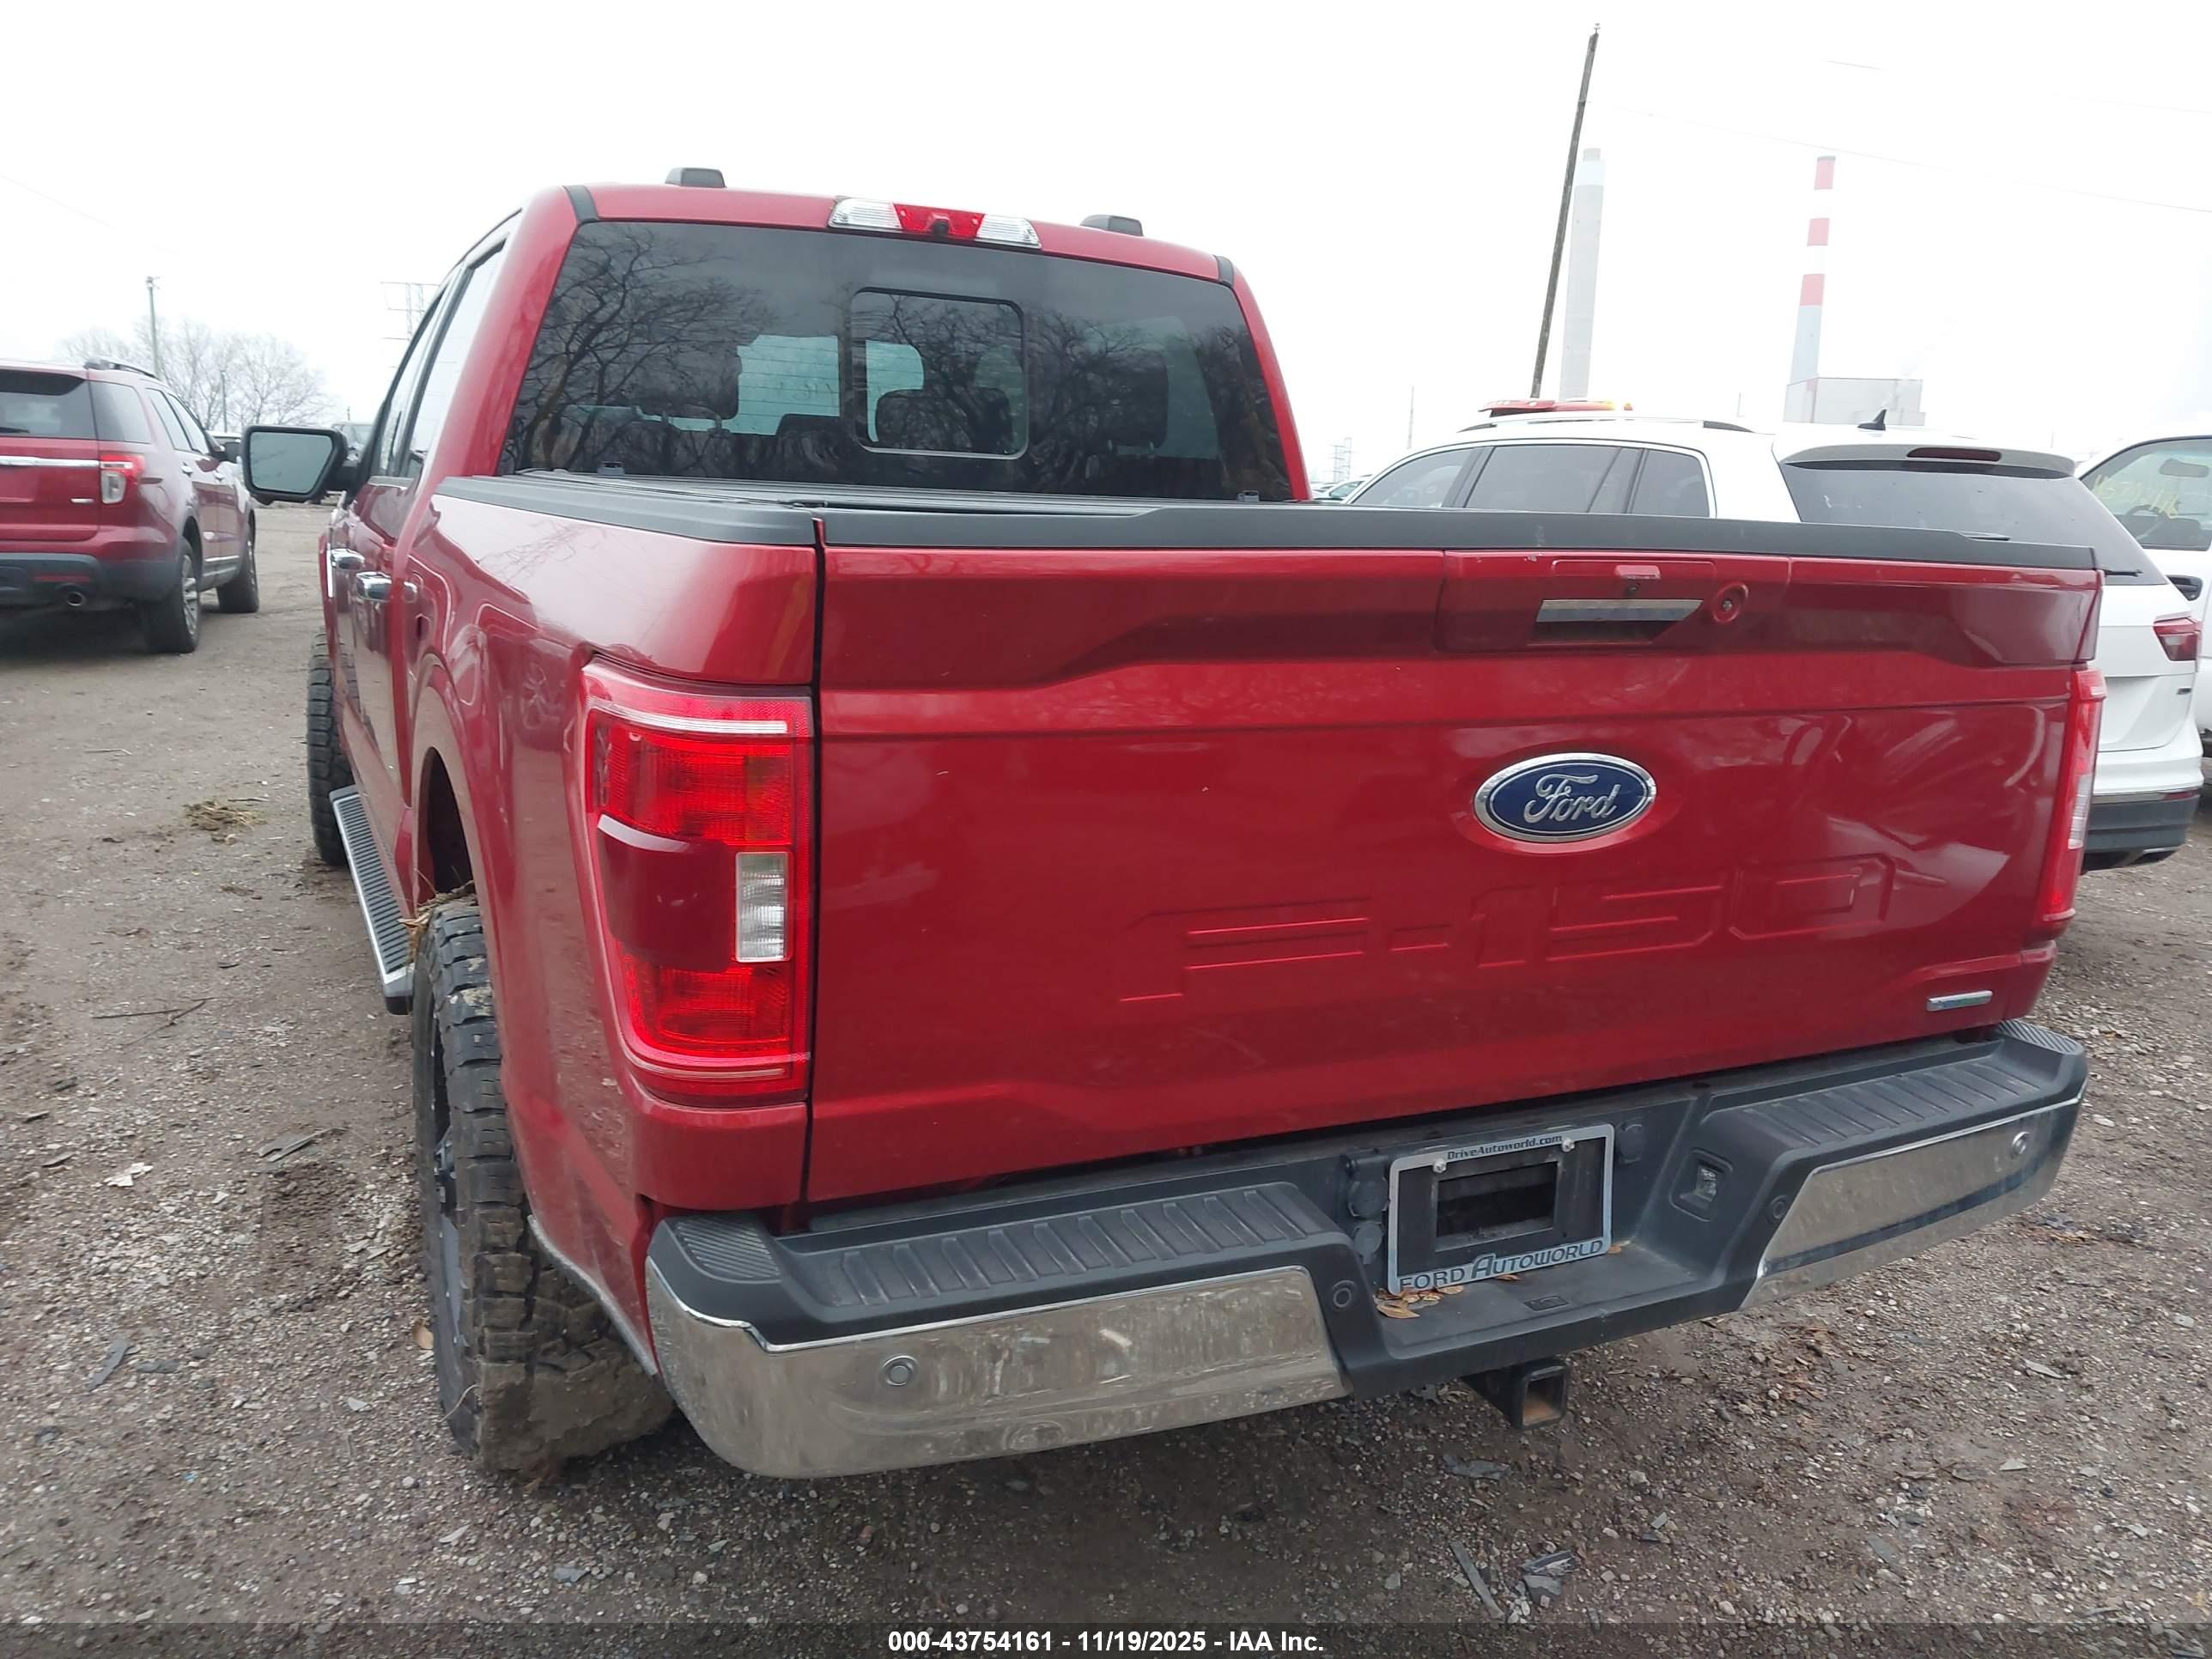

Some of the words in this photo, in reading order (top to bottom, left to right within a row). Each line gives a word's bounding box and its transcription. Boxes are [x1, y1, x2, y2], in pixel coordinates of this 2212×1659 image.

[1523, 774, 1622, 823] Ford
[1119, 853, 1893, 1002] F-150
[1446, 1134, 1564, 1161] DriveAutoworld.com
[1399, 1267, 1465, 1290] FORD
